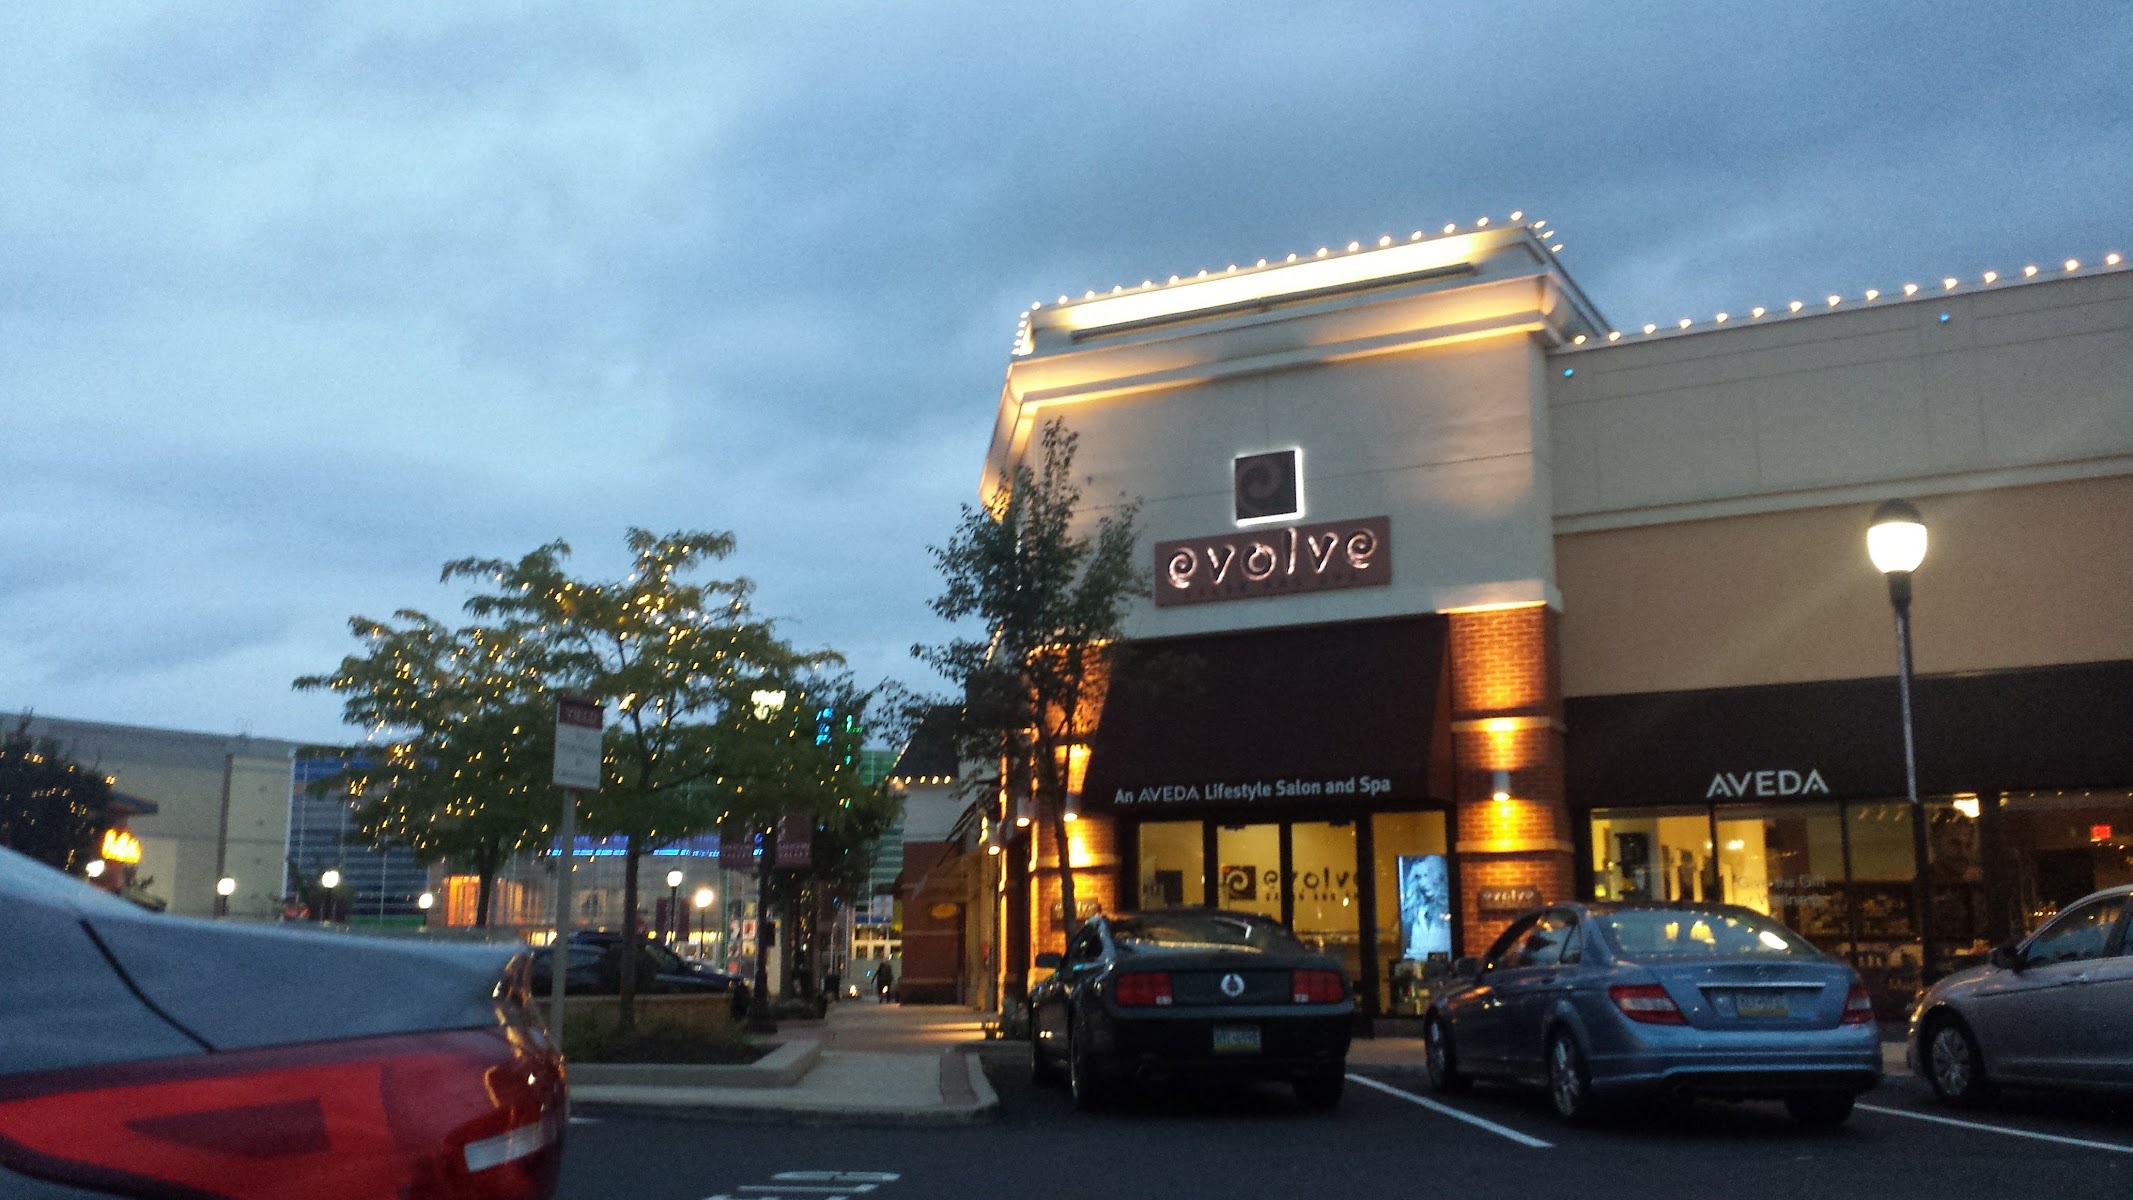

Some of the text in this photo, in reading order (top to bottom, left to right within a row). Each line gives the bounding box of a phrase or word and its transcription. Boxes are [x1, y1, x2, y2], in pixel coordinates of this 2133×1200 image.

[1168, 527, 1378, 589] evolve
[1114, 775, 1391, 804] An AVEDA Lifestyle Salon and Spa
[1706, 768, 1830, 798] AVEDA
[1263, 866, 1359, 890] eolv
